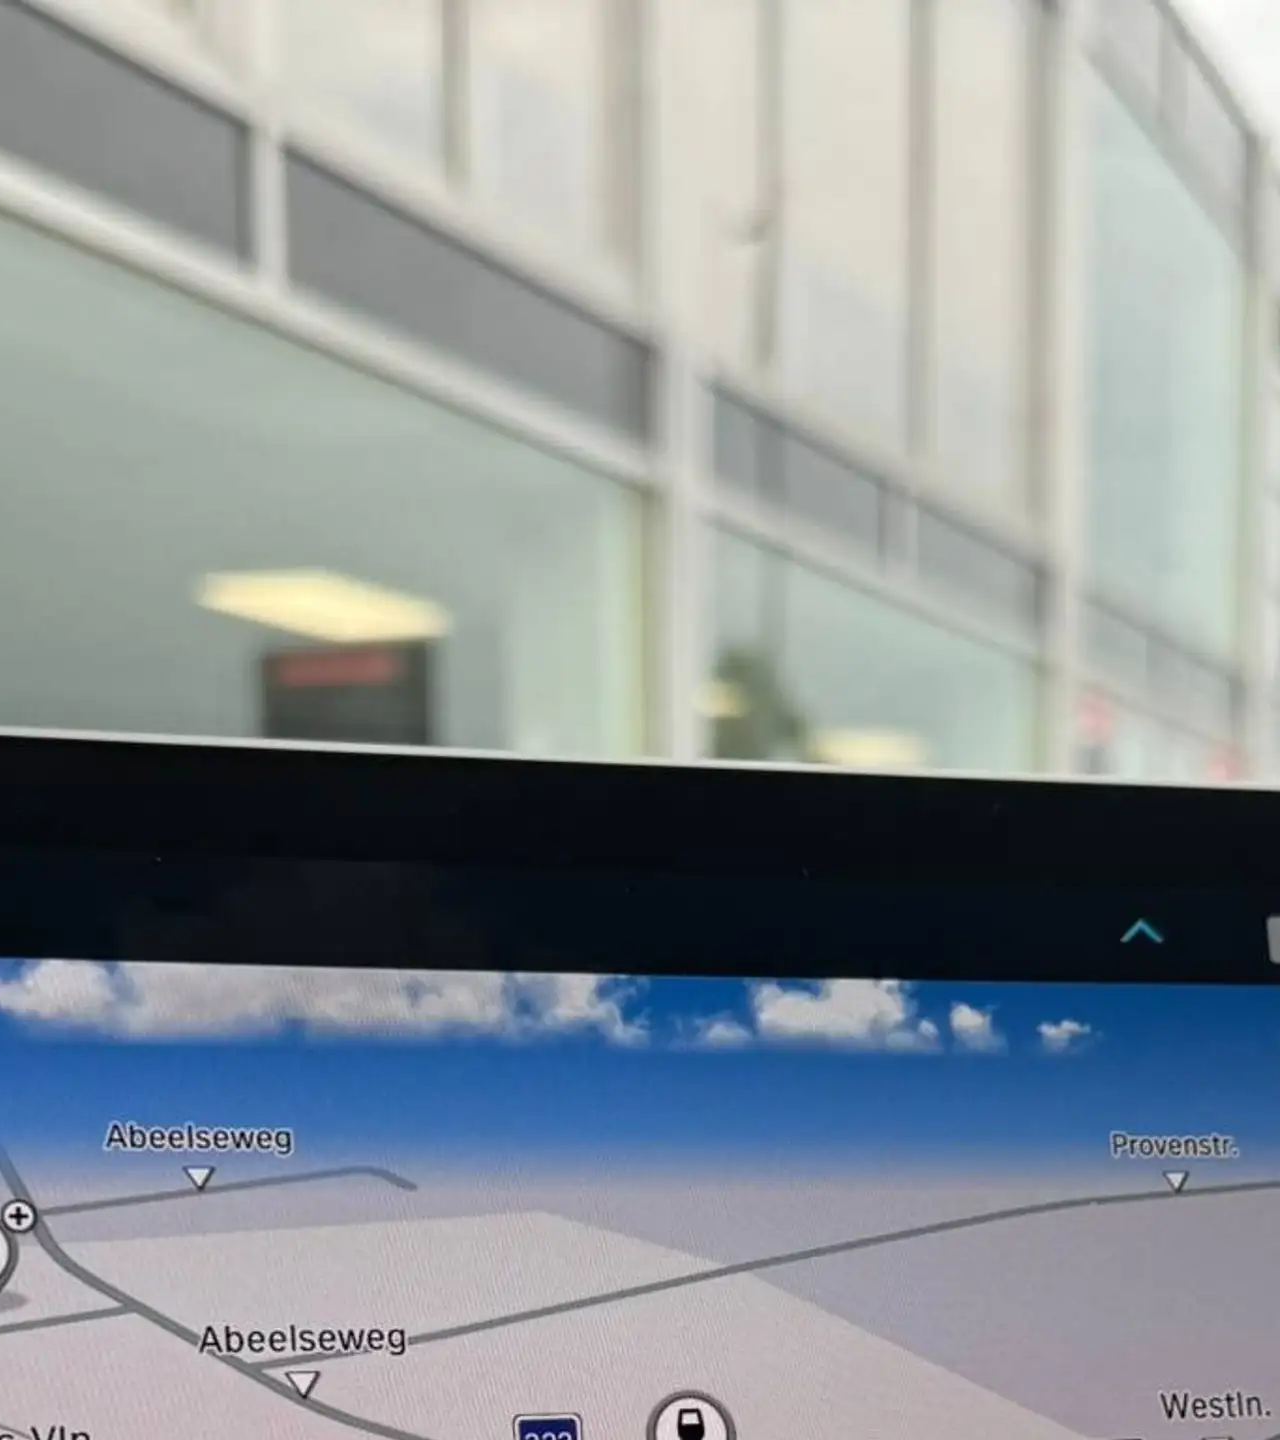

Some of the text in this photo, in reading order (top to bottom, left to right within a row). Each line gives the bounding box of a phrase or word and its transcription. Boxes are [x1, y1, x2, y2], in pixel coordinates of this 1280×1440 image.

[105, 1122, 294, 1155] Abeelseweg
[1111, 1131, 1239, 1159] Provenstr.
[200, 1325, 408, 1357] Abeelseweg
[1161, 1391, 1271, 1421] Westln.
